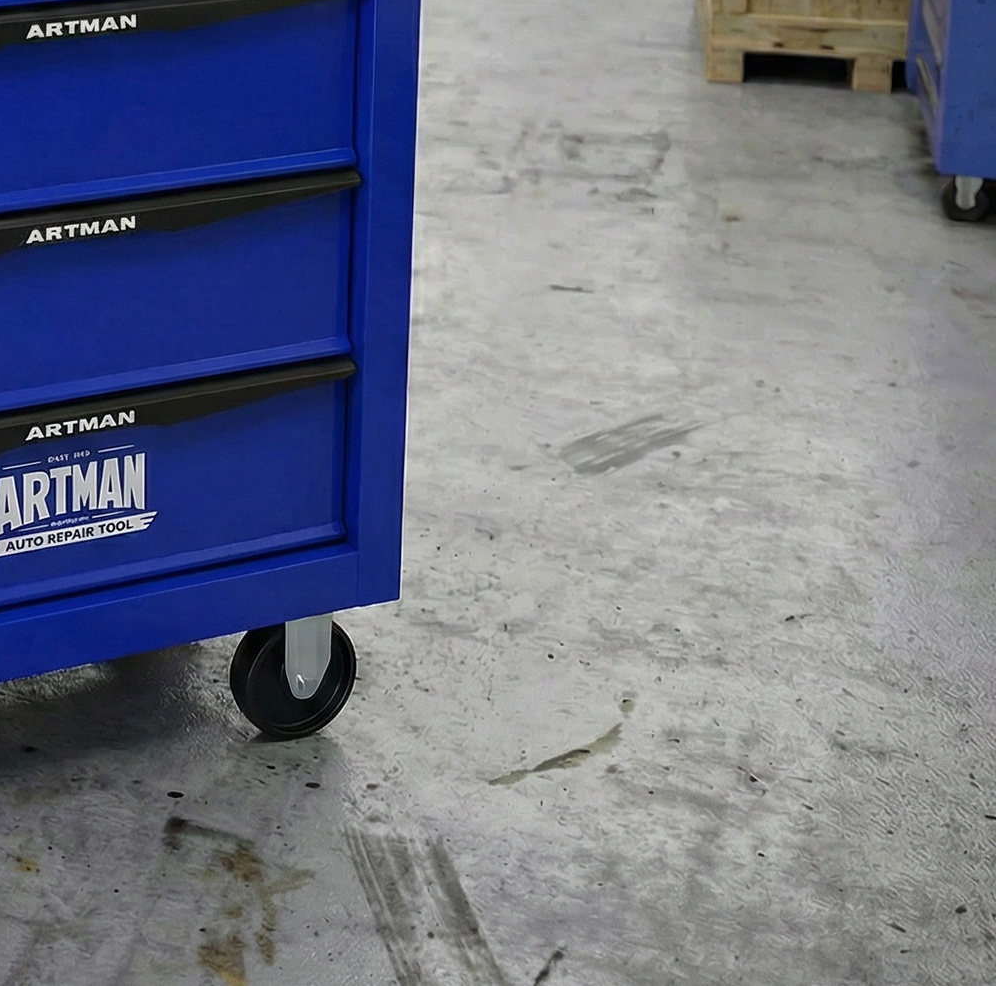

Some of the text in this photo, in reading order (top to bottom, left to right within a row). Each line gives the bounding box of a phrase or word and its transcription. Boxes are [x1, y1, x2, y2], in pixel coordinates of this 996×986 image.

[25, 13, 138, 40] ARTMAN
[25, 215, 137, 245] ARTMAN
[24, 409, 136, 442] ARTMAN
[5, 534, 44, 553] AUTO
[47, 526, 95, 545] REPAIR
[98, 519, 134, 535] TOOL
